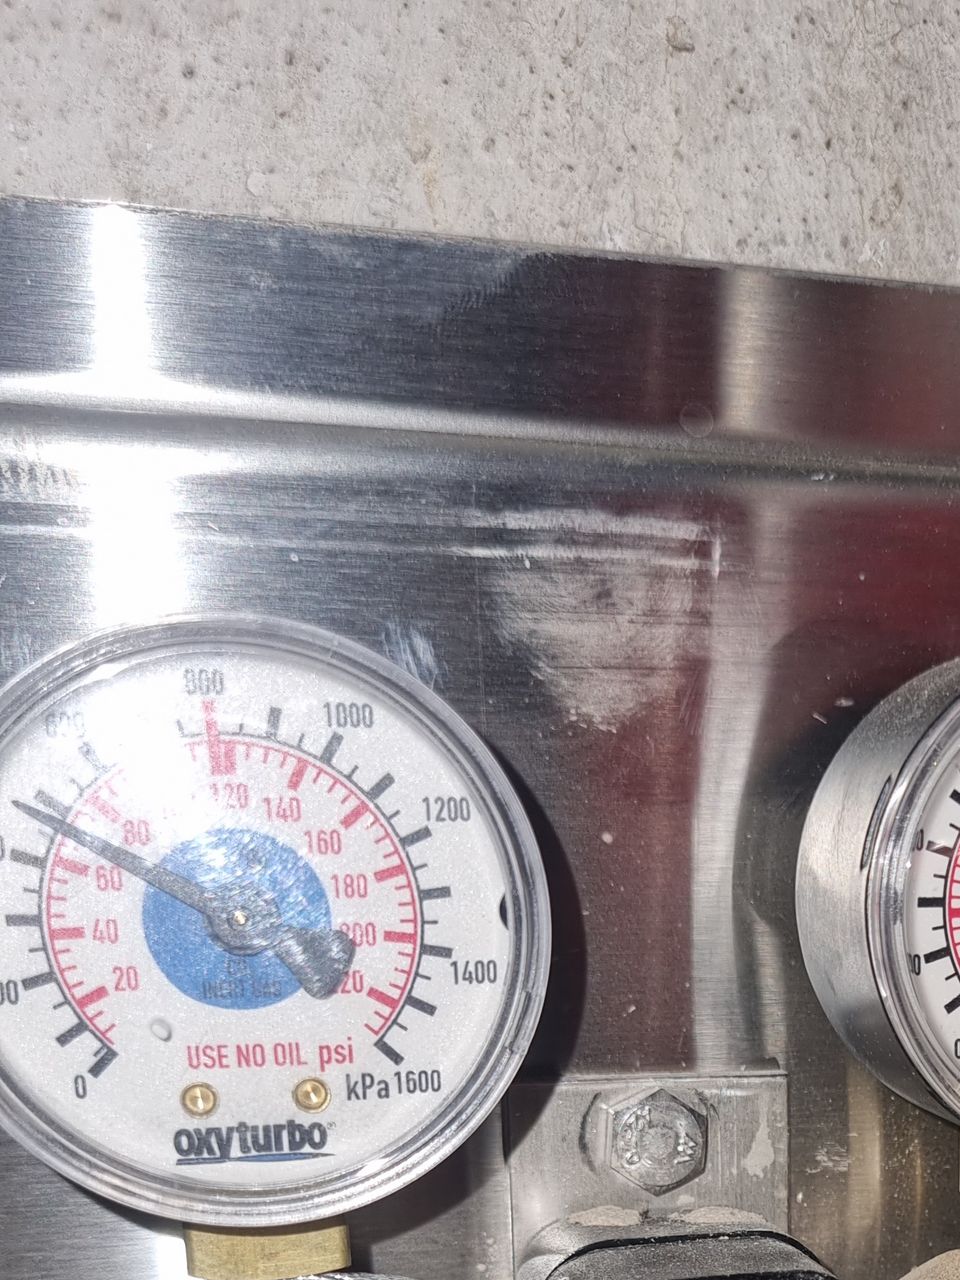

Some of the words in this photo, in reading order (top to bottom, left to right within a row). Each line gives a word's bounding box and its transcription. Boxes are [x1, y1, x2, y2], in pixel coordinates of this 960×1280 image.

[323, 702, 374, 728] 1000
[262, 797, 302, 823] 140
[422, 796, 472, 822] 1200
[122, 820, 152, 846] 80
[304, 830, 342, 855] 160
[96, 865, 123, 891] 60
[330, 874, 368, 898] 180
[92, 919, 119, 944] 40
[112, 966, 139, 991] 20
[450, 960, 498, 986] 1400
[187, 1045, 229, 1069] USE
[236, 1044, 266, 1067] NO
[274, 1042, 307, 1066] OIL
[319, 1036, 355, 1072] psi
[74, 1075, 88, 1099] 0
[346, 1073, 390, 1101] kPa
[394, 1070, 442, 1094] 1600
